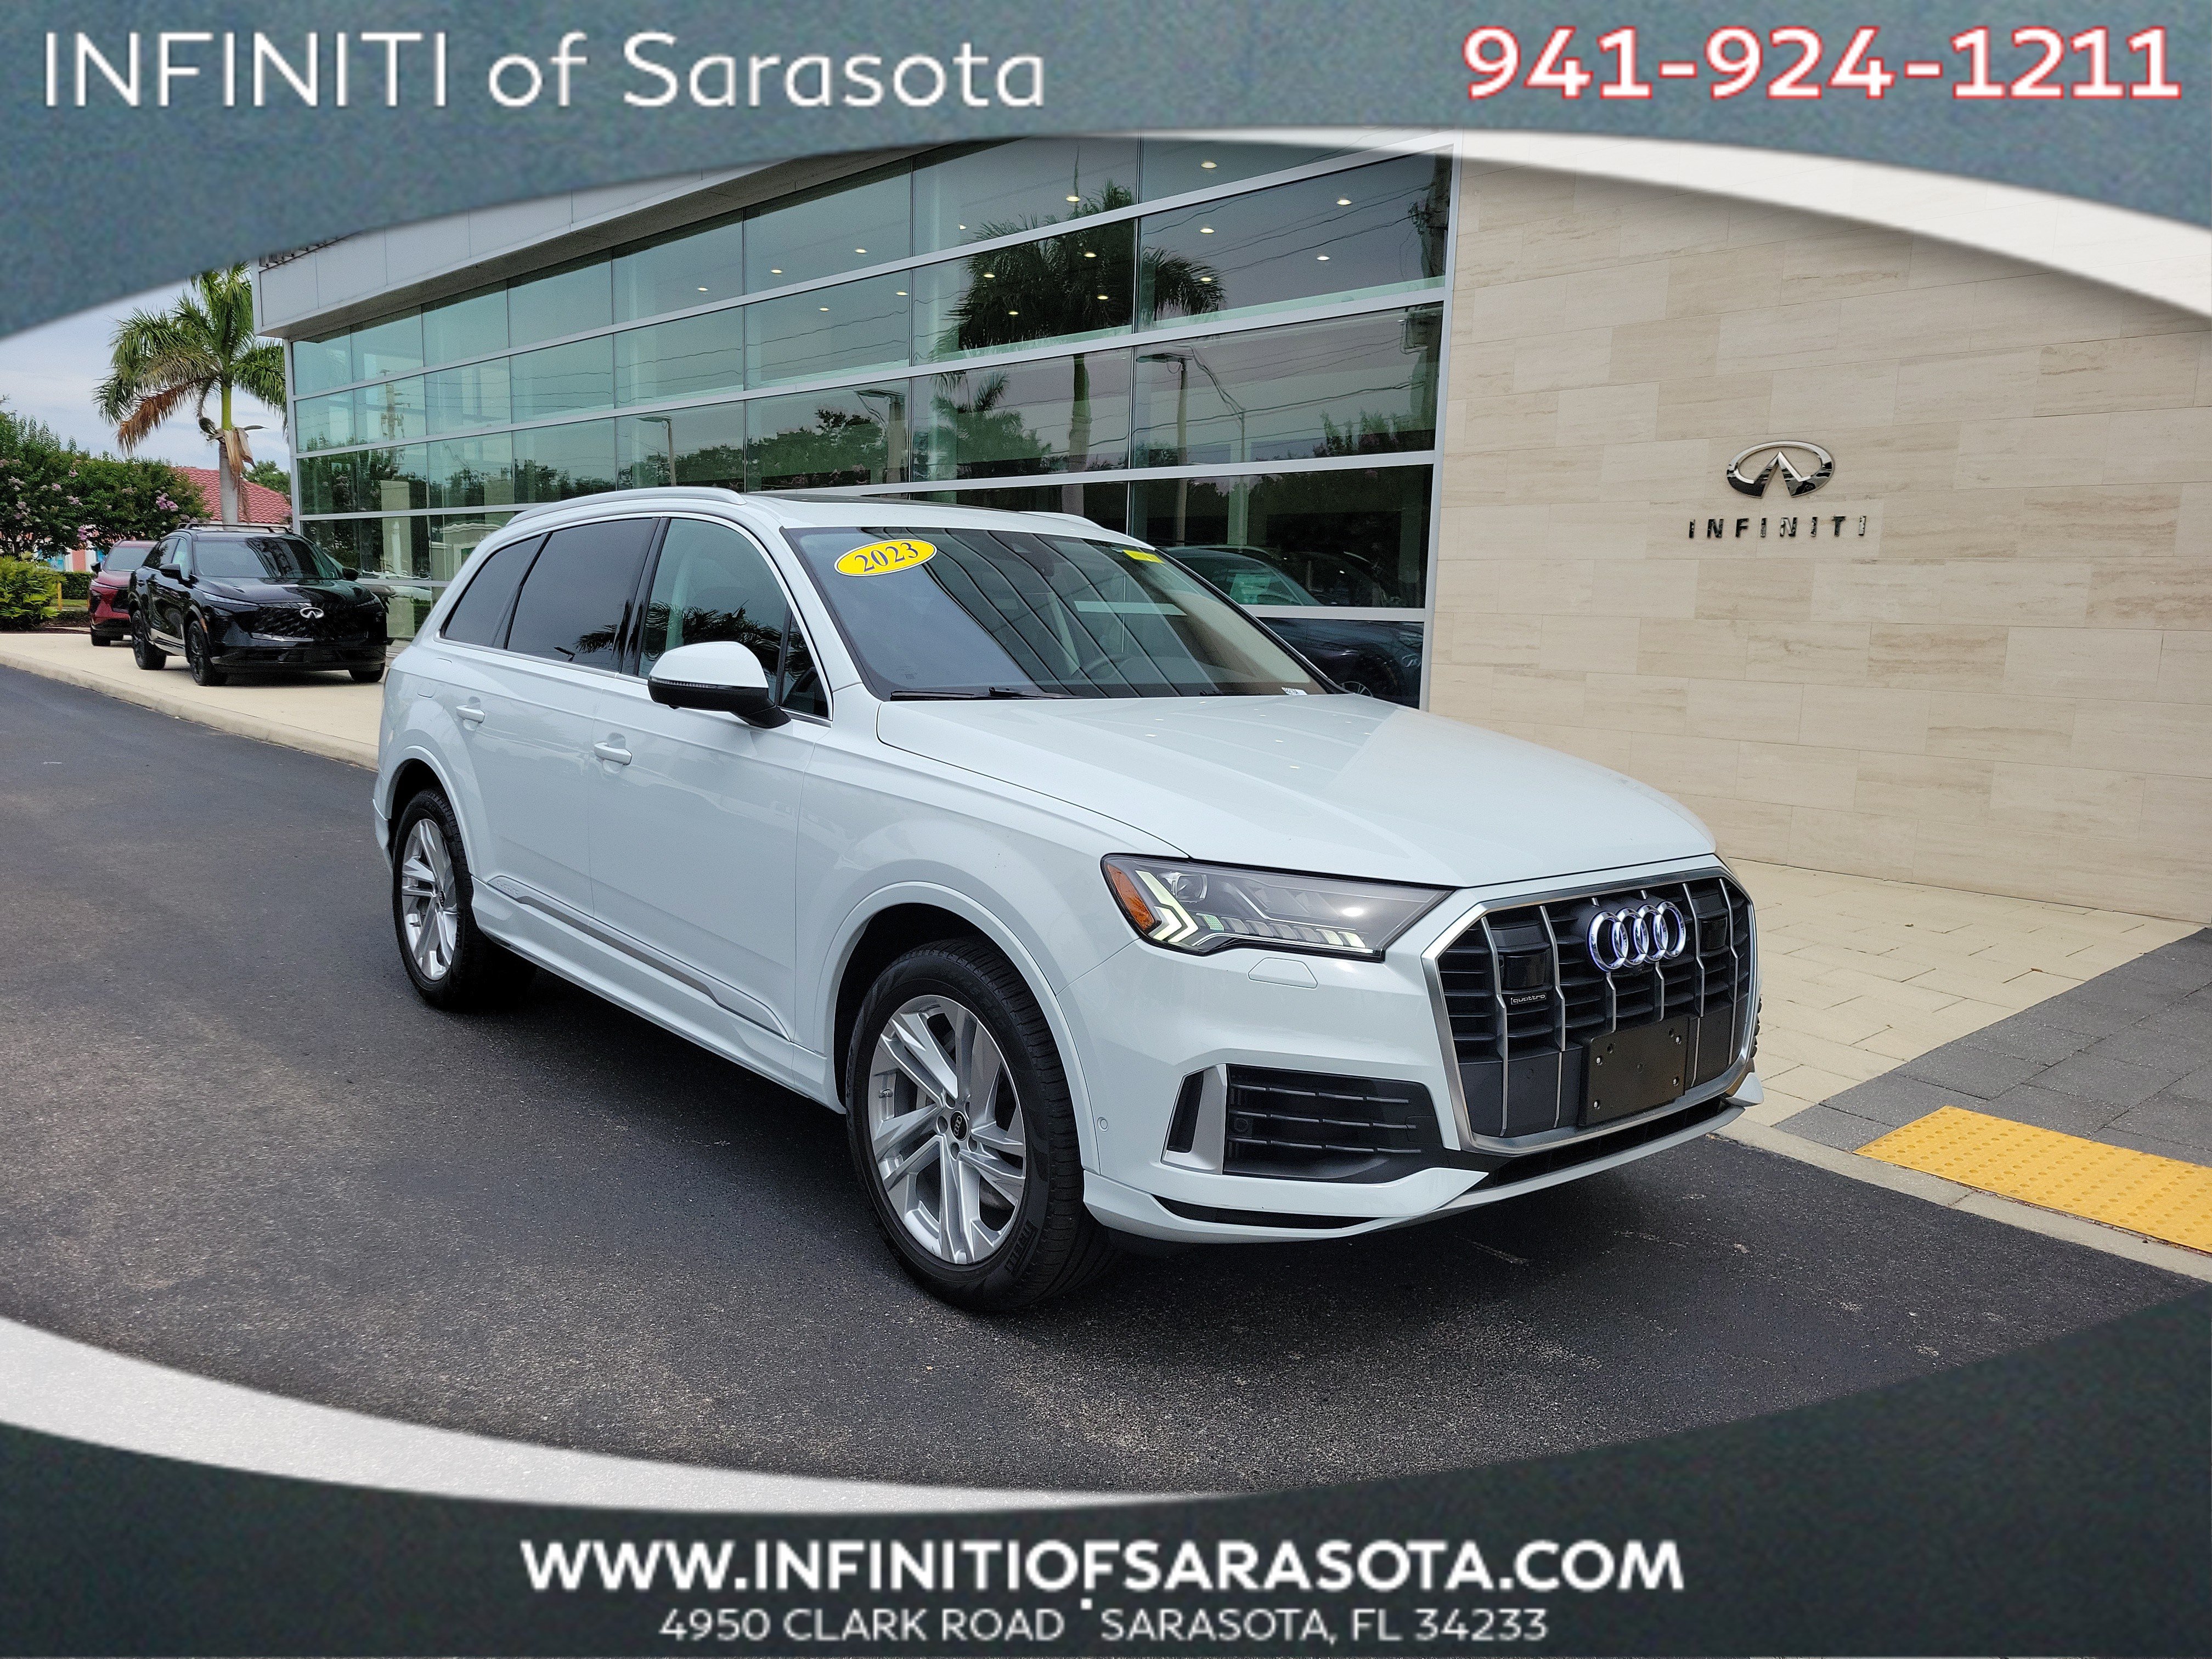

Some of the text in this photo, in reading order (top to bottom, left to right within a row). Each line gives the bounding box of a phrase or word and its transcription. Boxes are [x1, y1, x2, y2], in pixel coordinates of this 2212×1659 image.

[1689, 515, 1866, 539] INFINITI
[854, 542, 918, 572] 2023
[1513, 994, 1545, 1003] quattro
